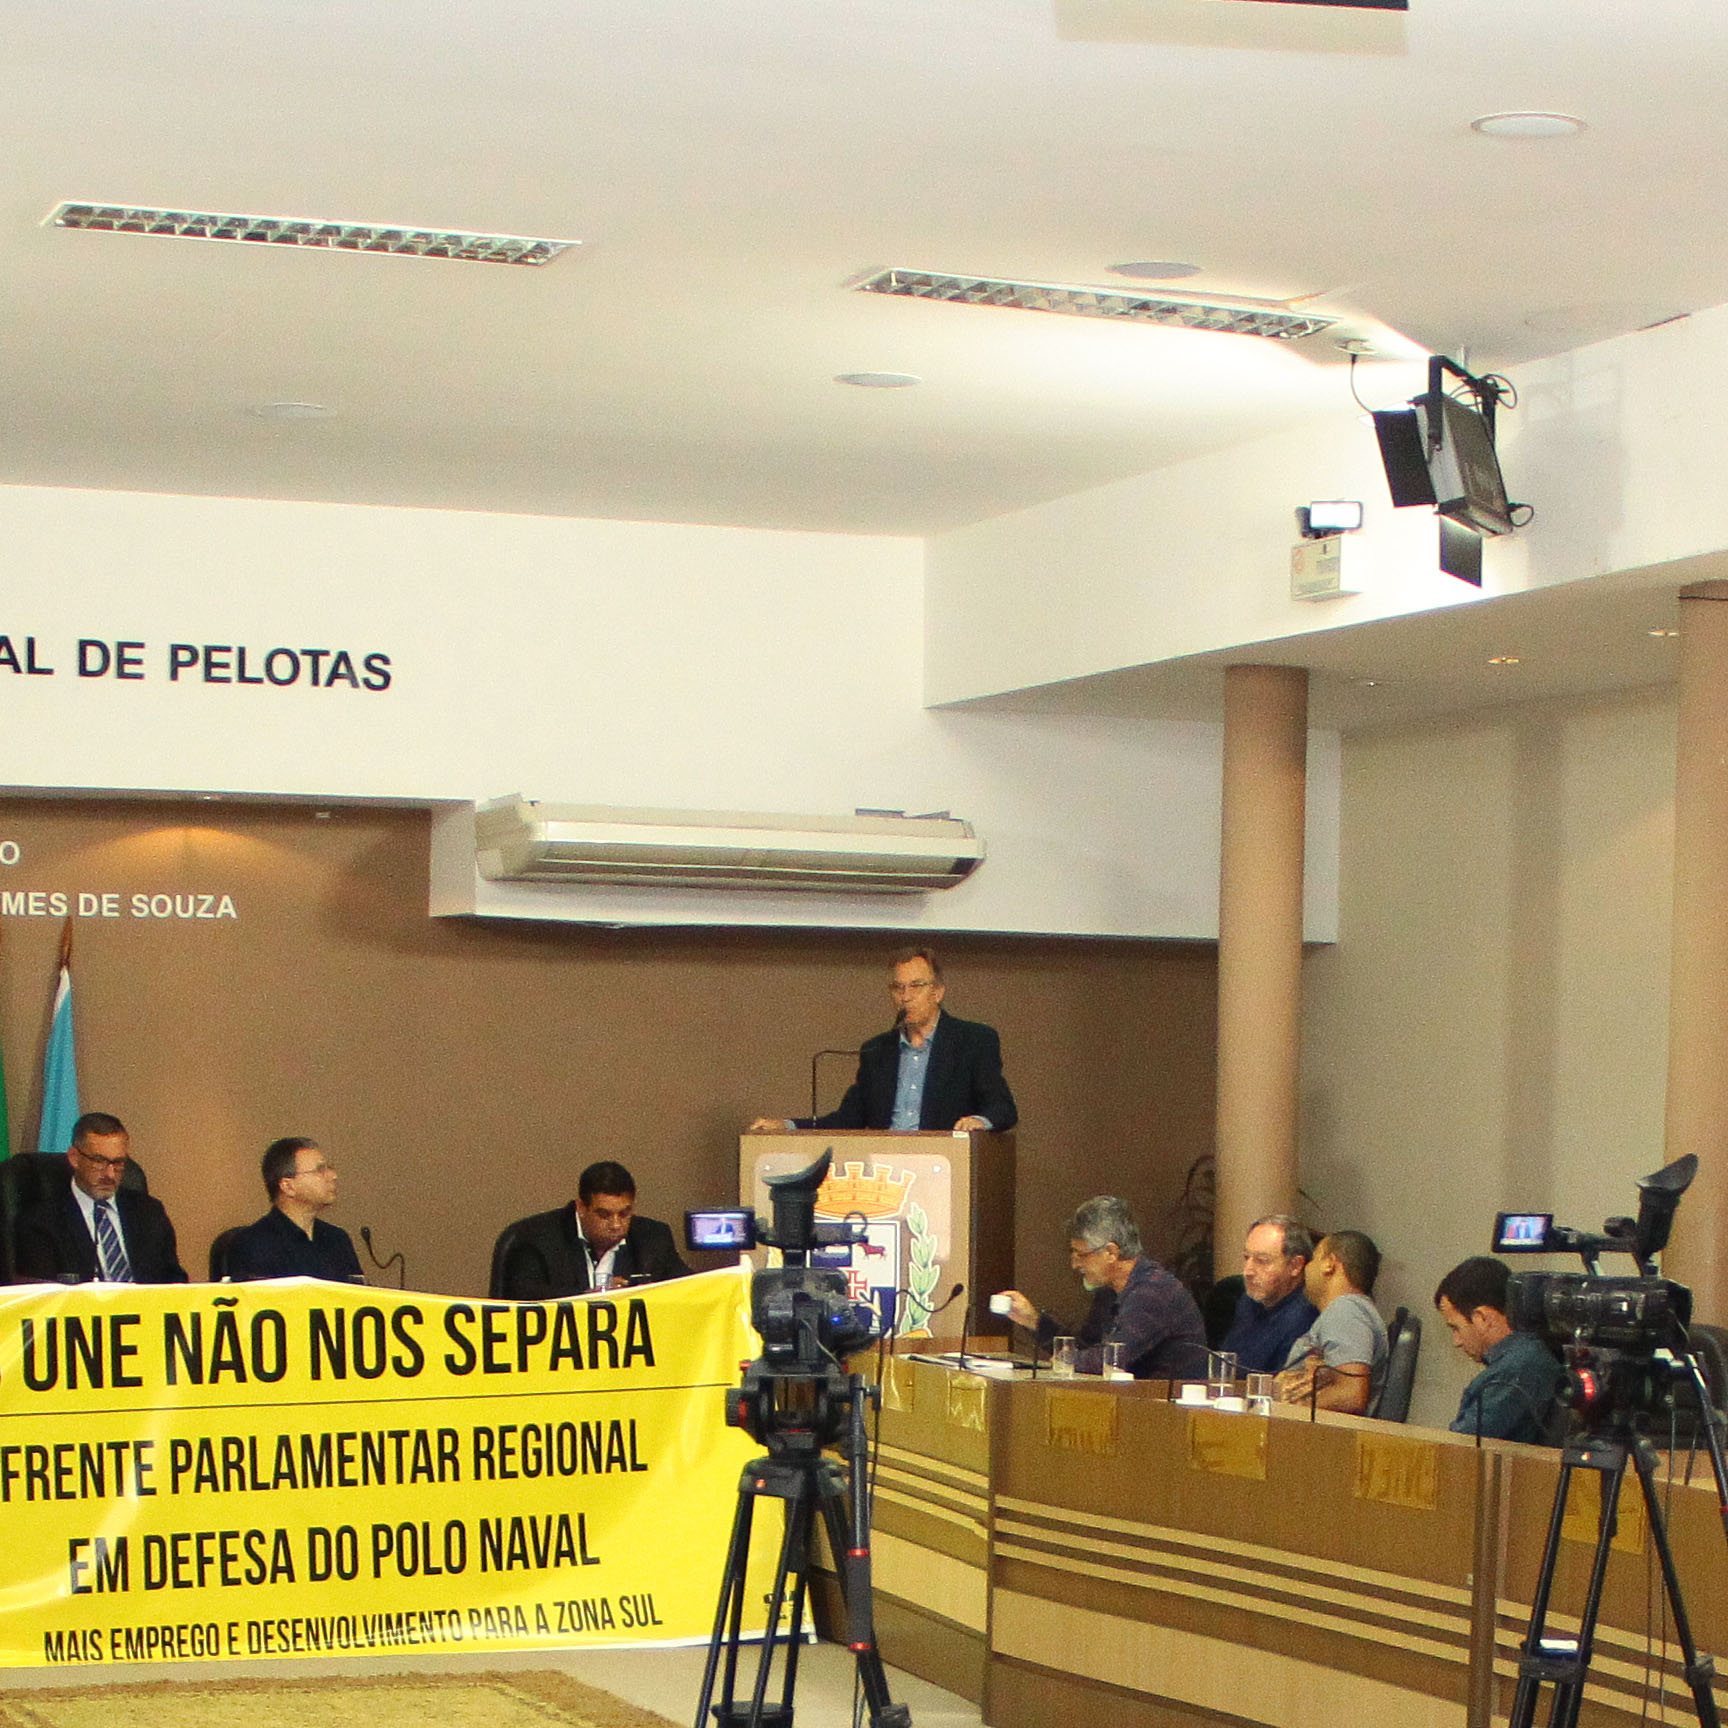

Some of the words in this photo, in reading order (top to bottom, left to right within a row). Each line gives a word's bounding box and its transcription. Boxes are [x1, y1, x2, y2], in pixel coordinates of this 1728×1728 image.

[77, 639, 145, 680] DE
[169, 643, 392, 692] PELOTAS
[78, 892, 120, 917] DE
[131, 893, 237, 919] SOUZA
[21, 1314, 143, 1392] UNE
[164, 1297, 288, 1385] NÃO
[309, 1305, 425, 1381] NOS
[443, 1299, 656, 1377] SEPARA
[0, 1440, 157, 1503] FRENTE
[170, 1427, 461, 1495] PARLAMENTAR
[473, 1419, 648, 1481] REGIONAL
[68, 1536, 130, 1595] EM
[143, 1528, 296, 1591] DEFESA
[307, 1525, 359, 1582] DO
[371, 1519, 467, 1579] POLO
[479, 1512, 600, 1573] NAVAL
[43, 1628, 103, 1662] MAIS
[110, 1622, 220, 1660] EMPREGO
[226, 1621, 240, 1656] E
[247, 1608, 463, 1655] DESENVOLVIMENTO
[468, 1602, 530, 1641] PARA
[535, 1602, 551, 1635] A
[553, 1597, 616, 1633] ZONA
[621, 1593, 664, 1629] SUL
